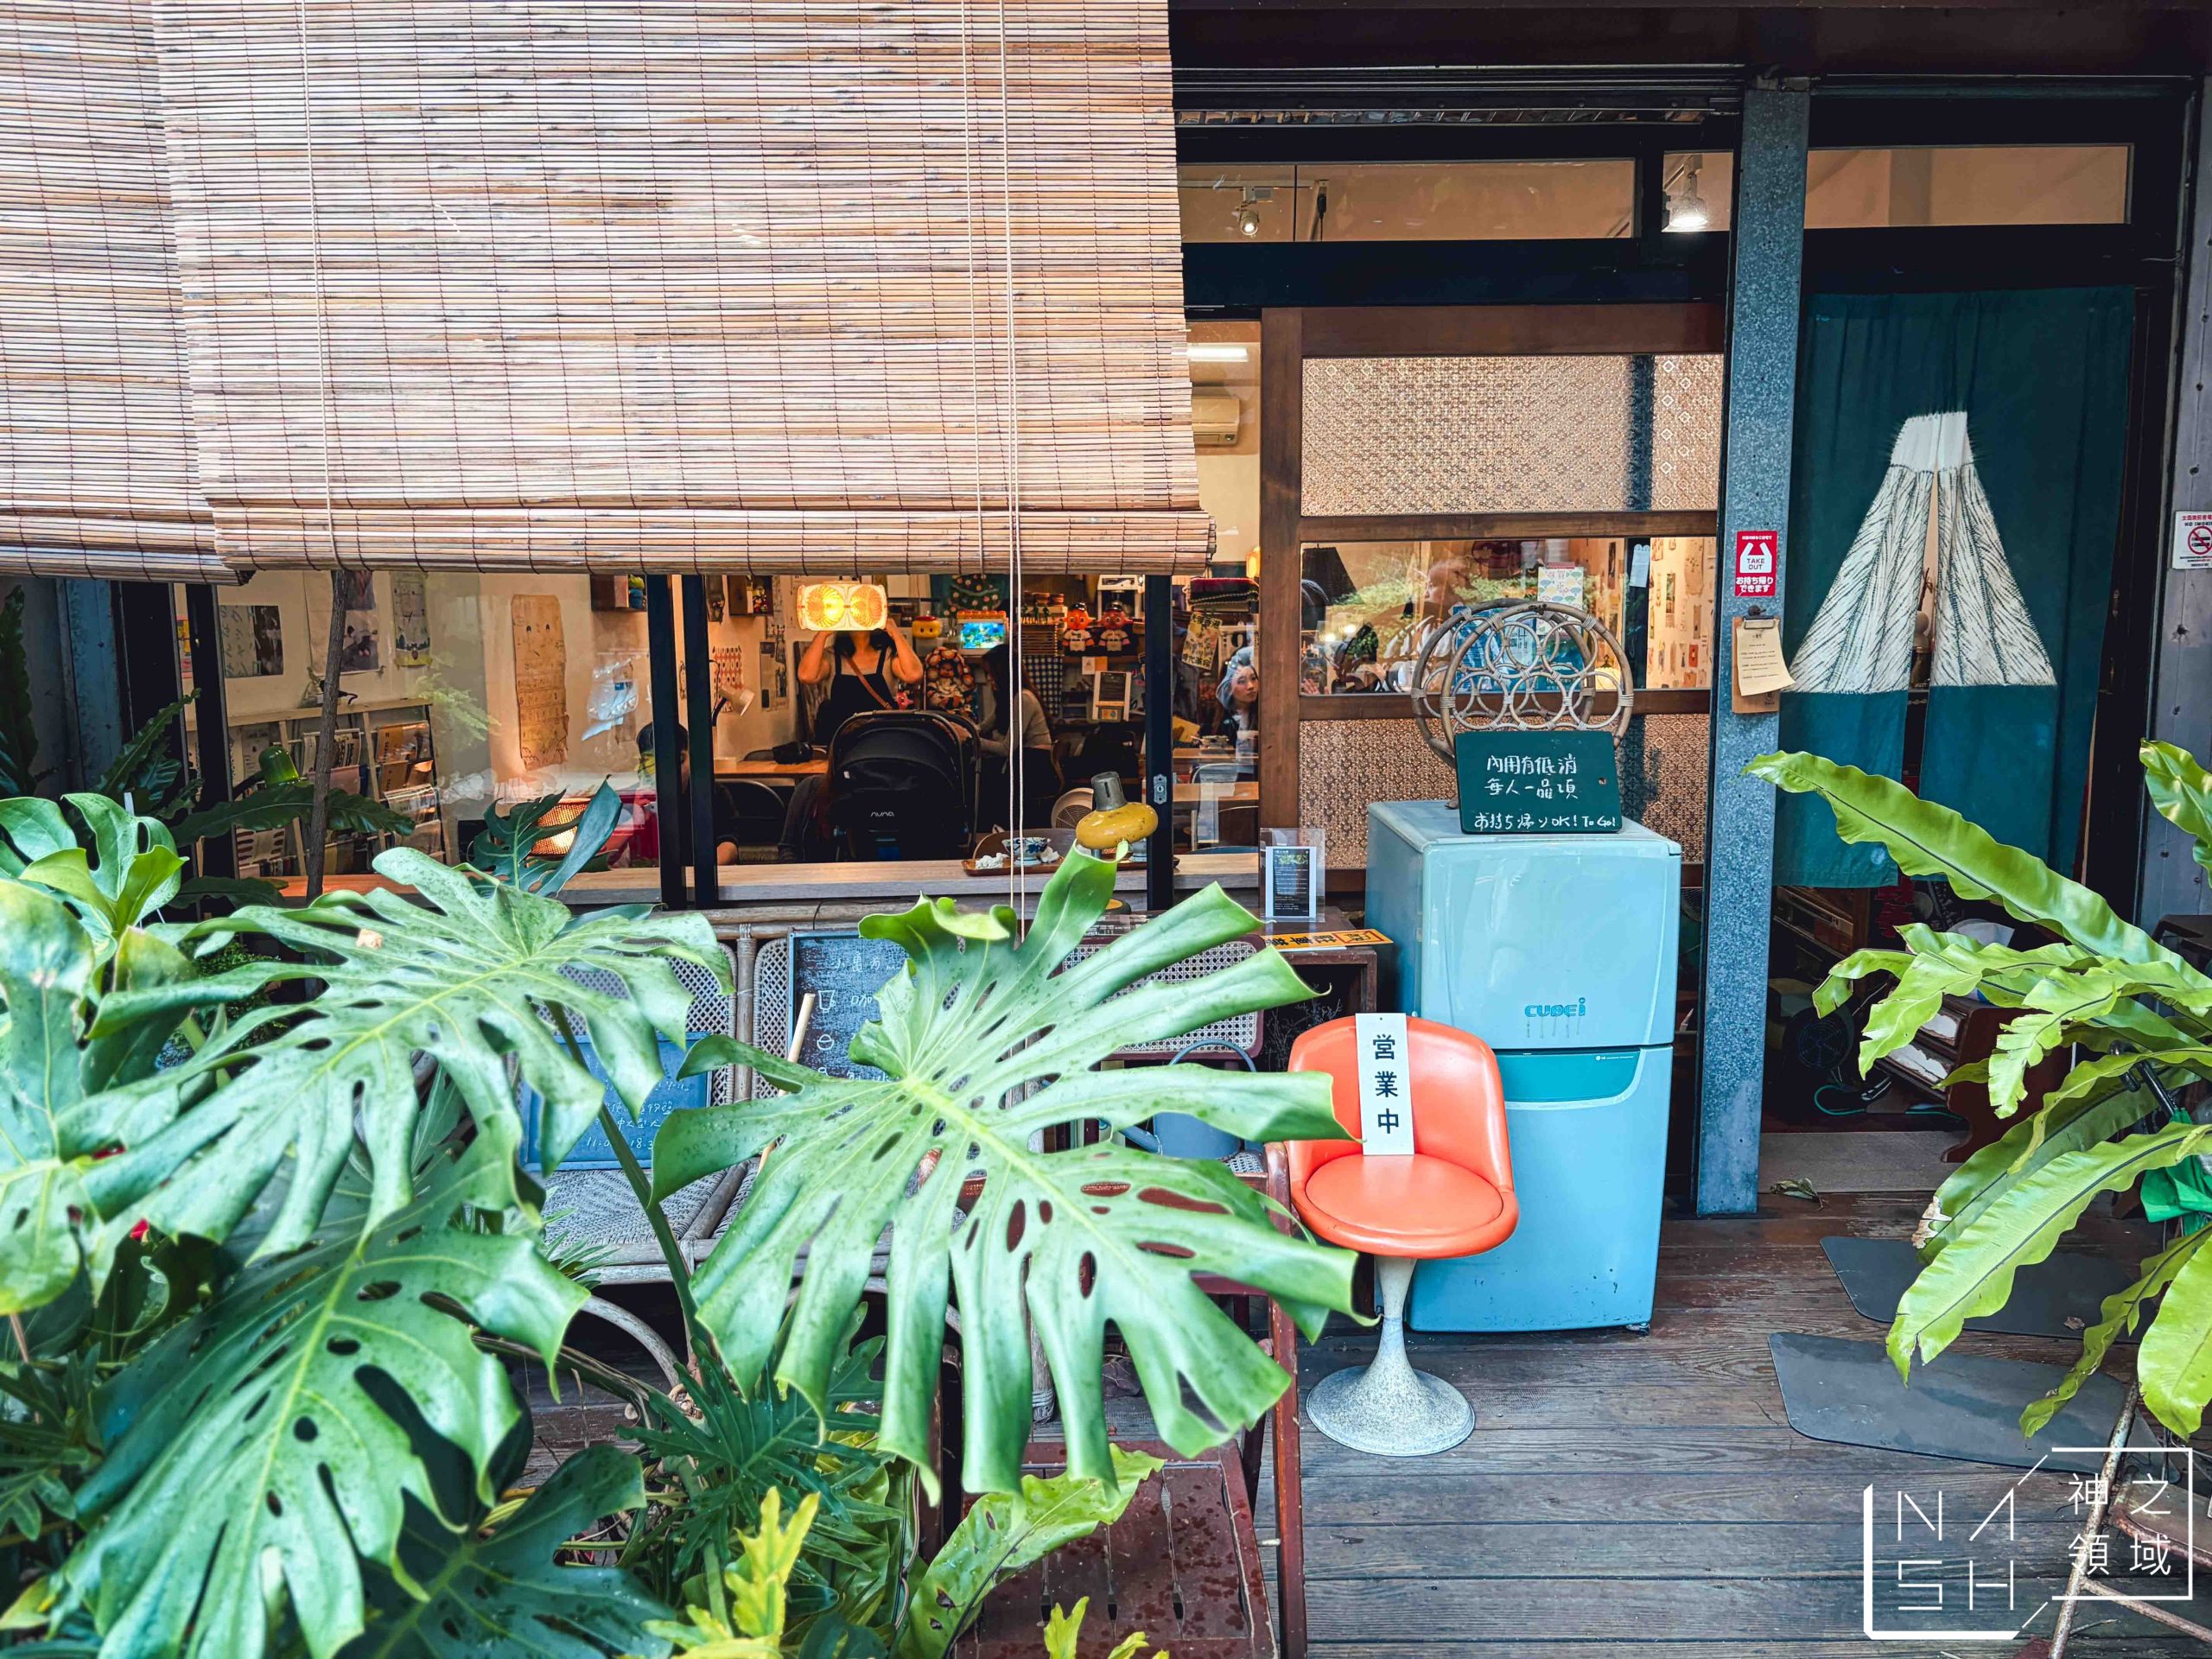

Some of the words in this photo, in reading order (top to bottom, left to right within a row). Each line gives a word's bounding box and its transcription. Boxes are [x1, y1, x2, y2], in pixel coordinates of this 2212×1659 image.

[1736, 576, 1774, 585] お持ち帰り
[1739, 584, 1770, 593] できます
[1582, 816, 1594, 828] To
[1372, 1033, 1399, 1135] 営業中
